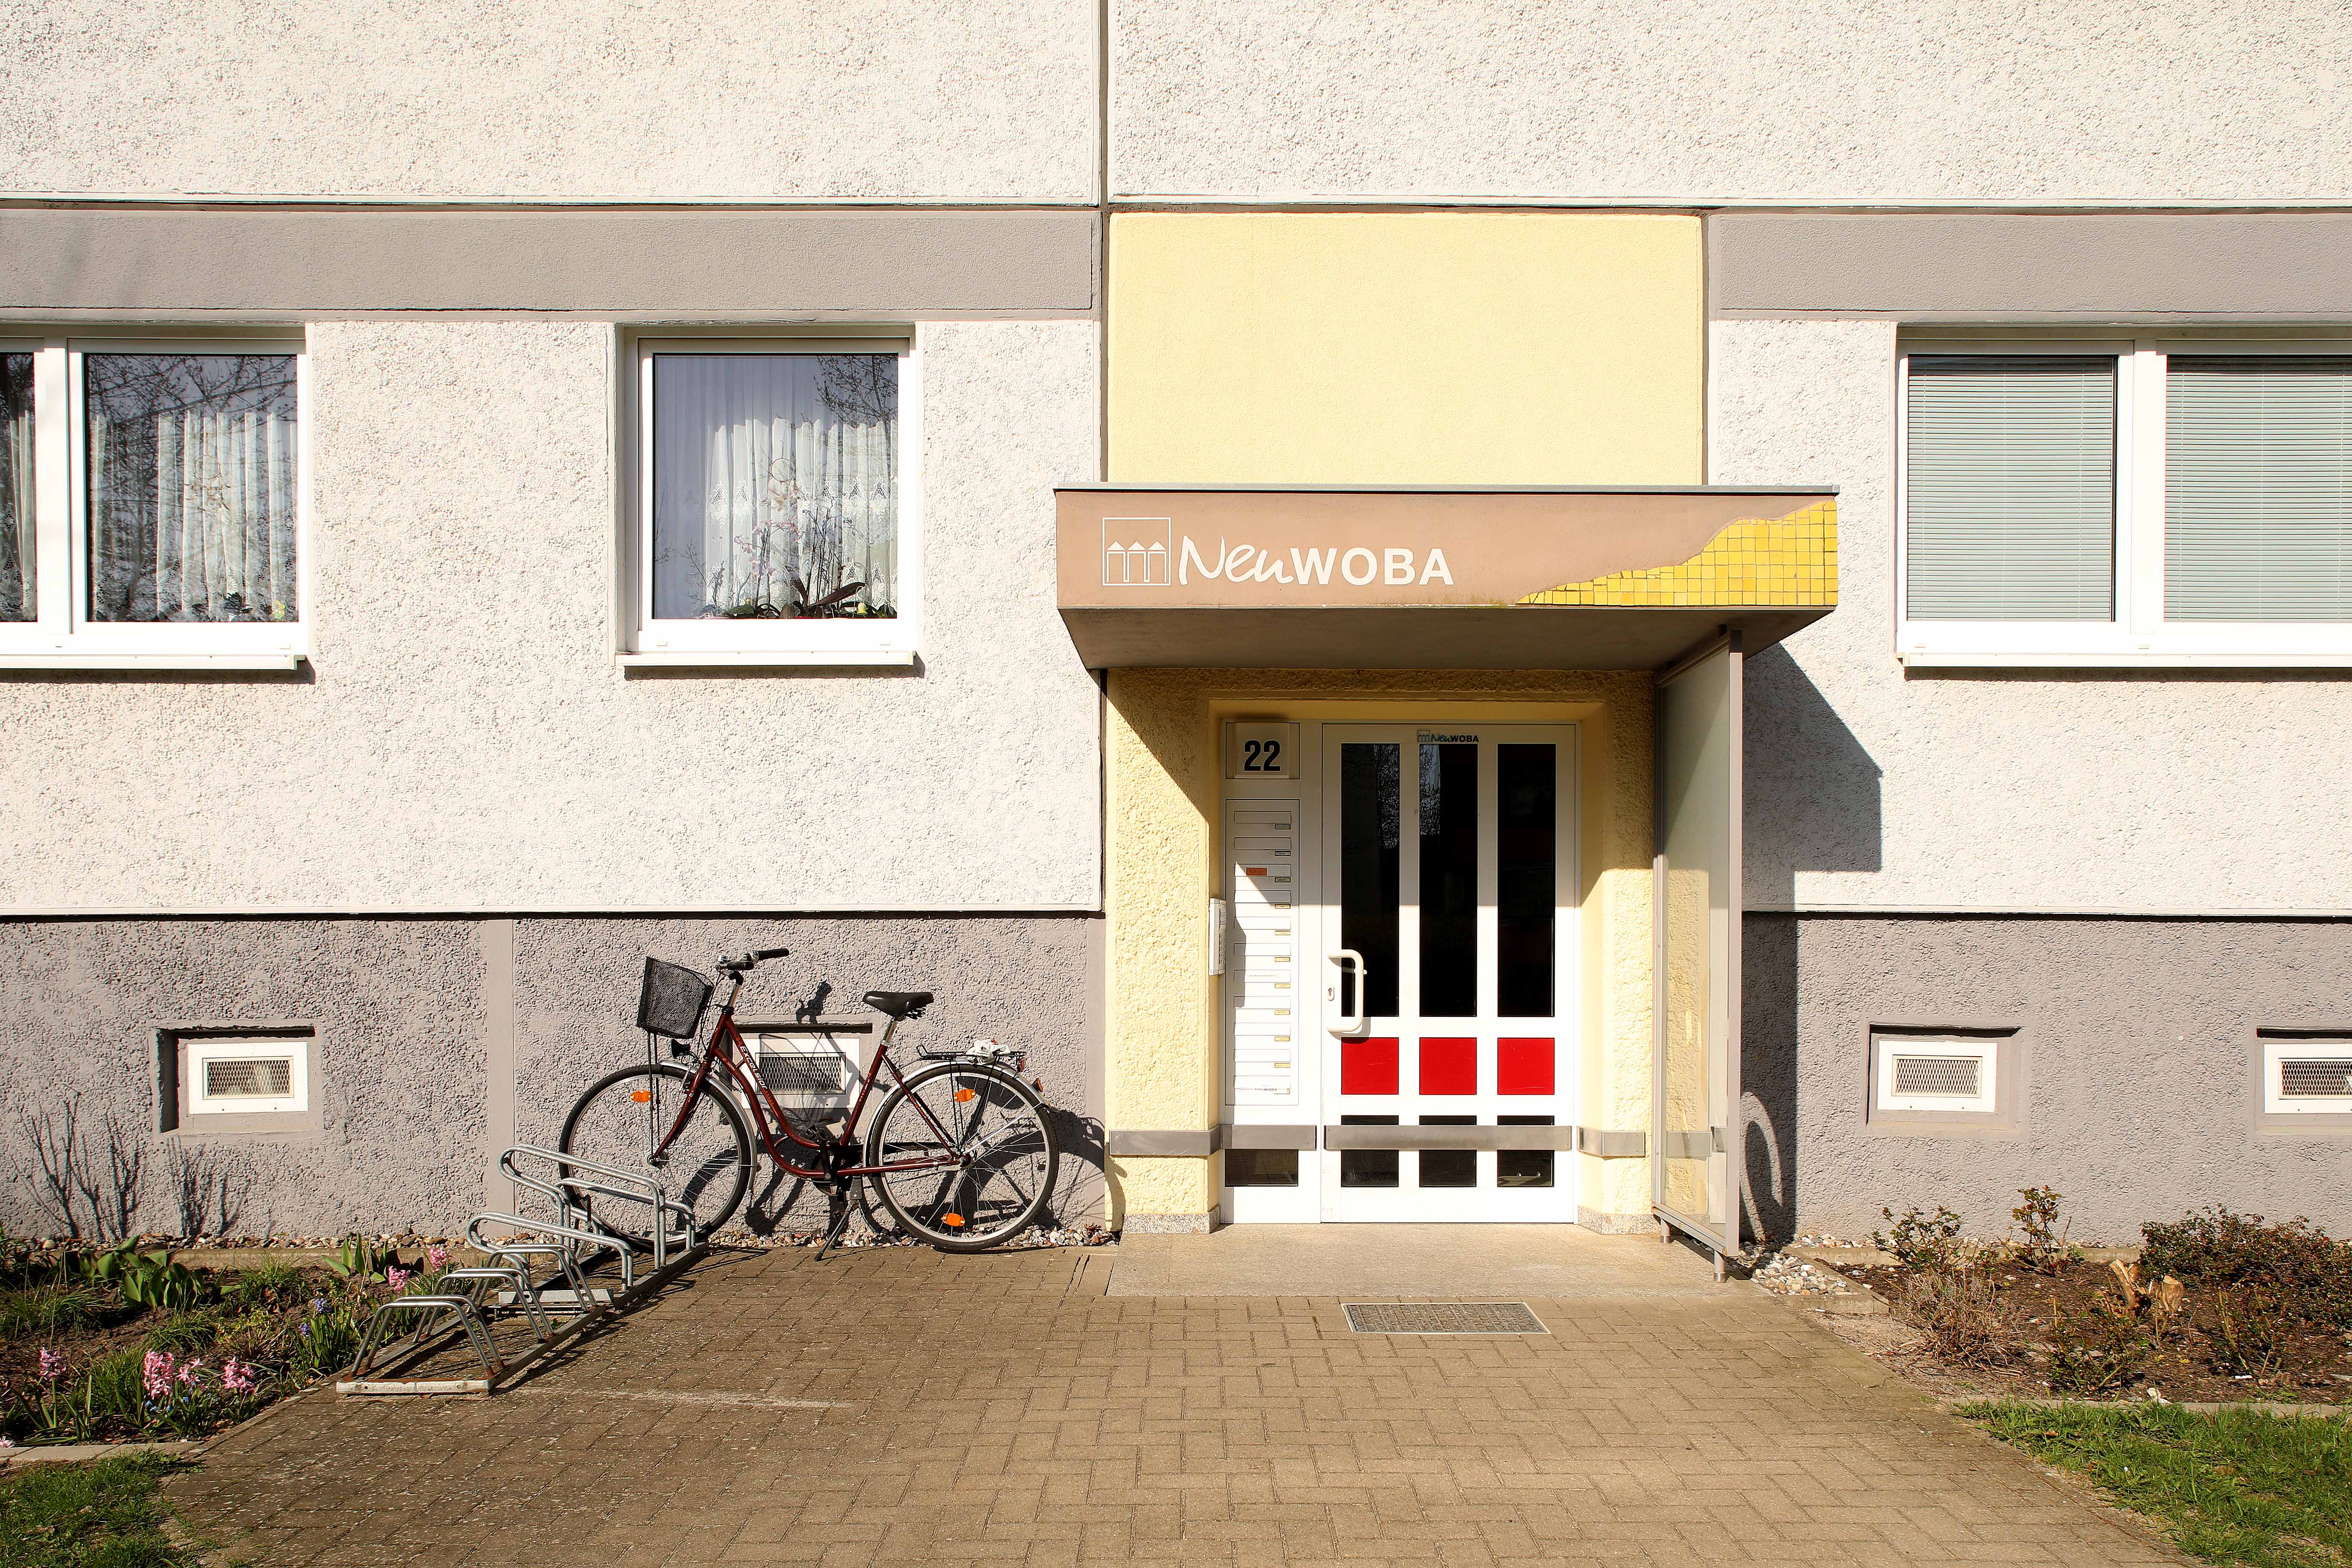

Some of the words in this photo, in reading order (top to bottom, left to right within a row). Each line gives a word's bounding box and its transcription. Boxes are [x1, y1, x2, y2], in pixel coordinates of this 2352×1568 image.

[1178, 534, 1454, 586] NeuWOBA
[1430, 732, 1479, 743] NeuWOBA
[1244, 740, 1281, 772] 22
